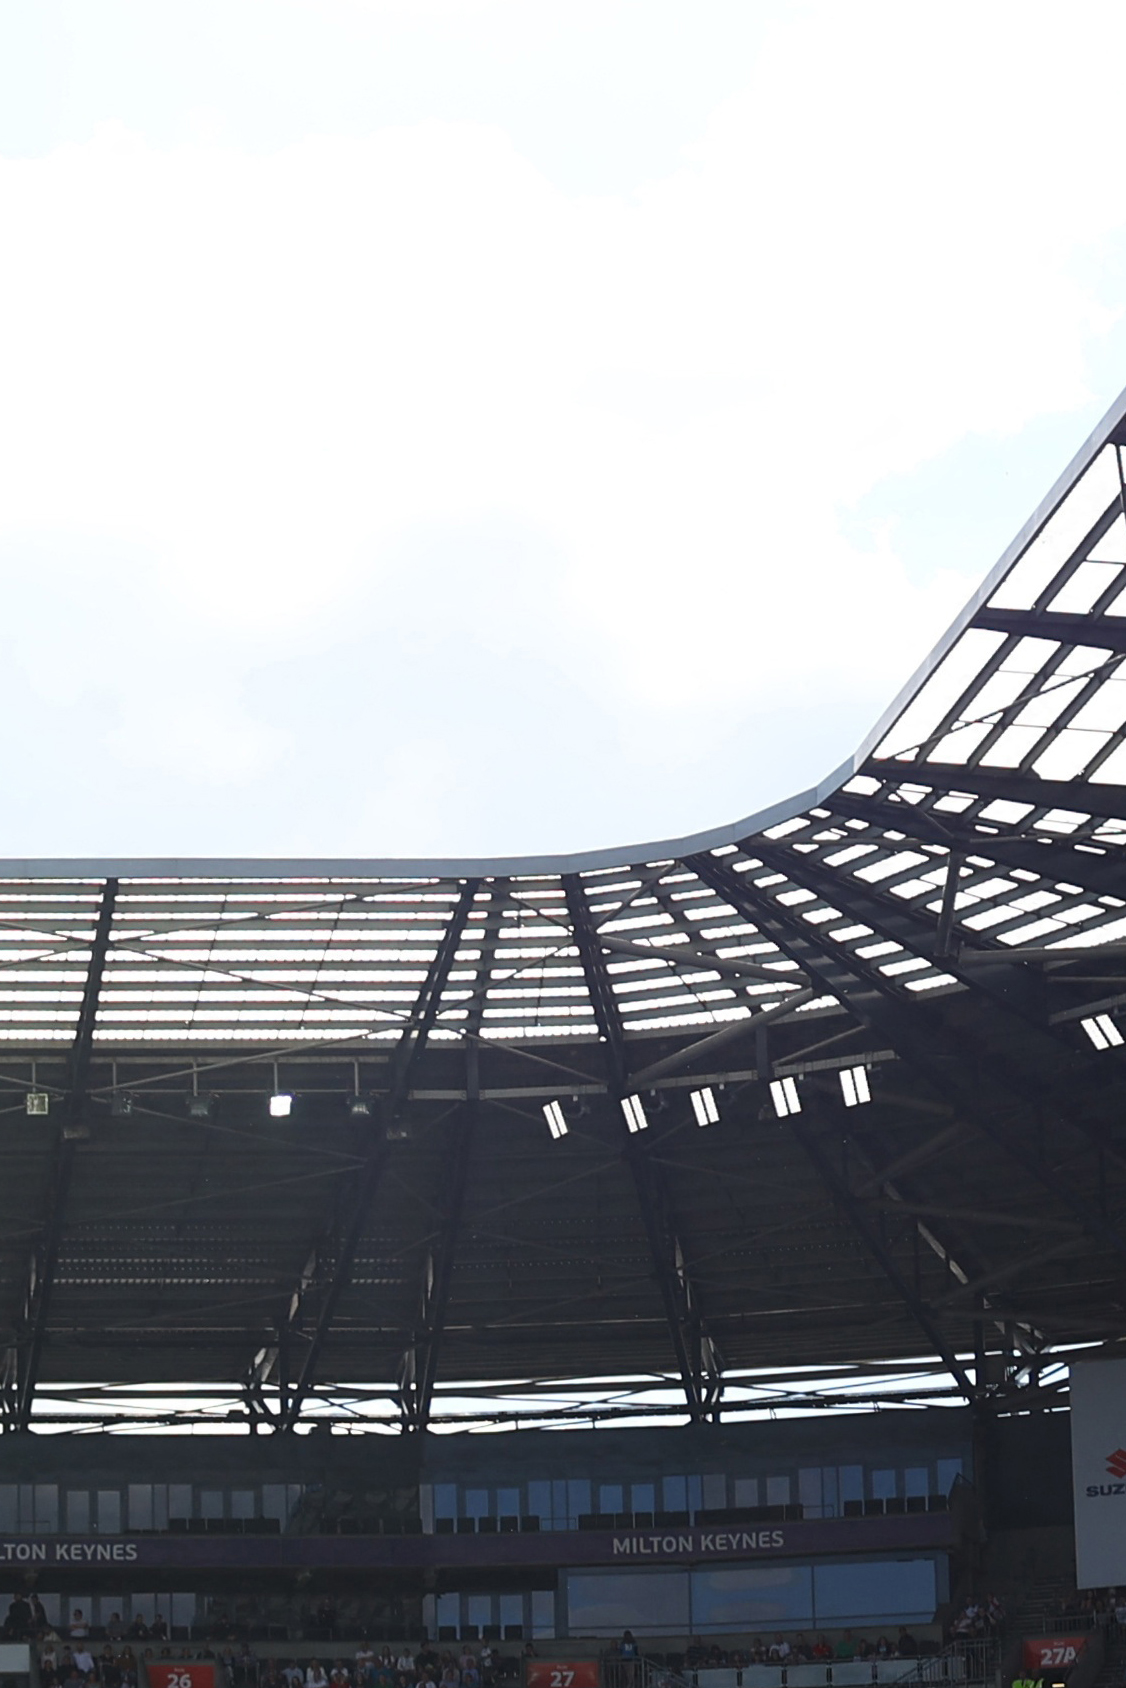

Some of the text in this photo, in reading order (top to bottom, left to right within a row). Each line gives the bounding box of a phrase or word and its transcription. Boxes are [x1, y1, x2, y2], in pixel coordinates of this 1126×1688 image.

[56, 1543, 138, 1560] KEYNES
[612, 1530, 784, 1555] MILTON KEYNES
[1041, 1646, 1079, 1665] 27A
[550, 1671, 575, 1688] 27
